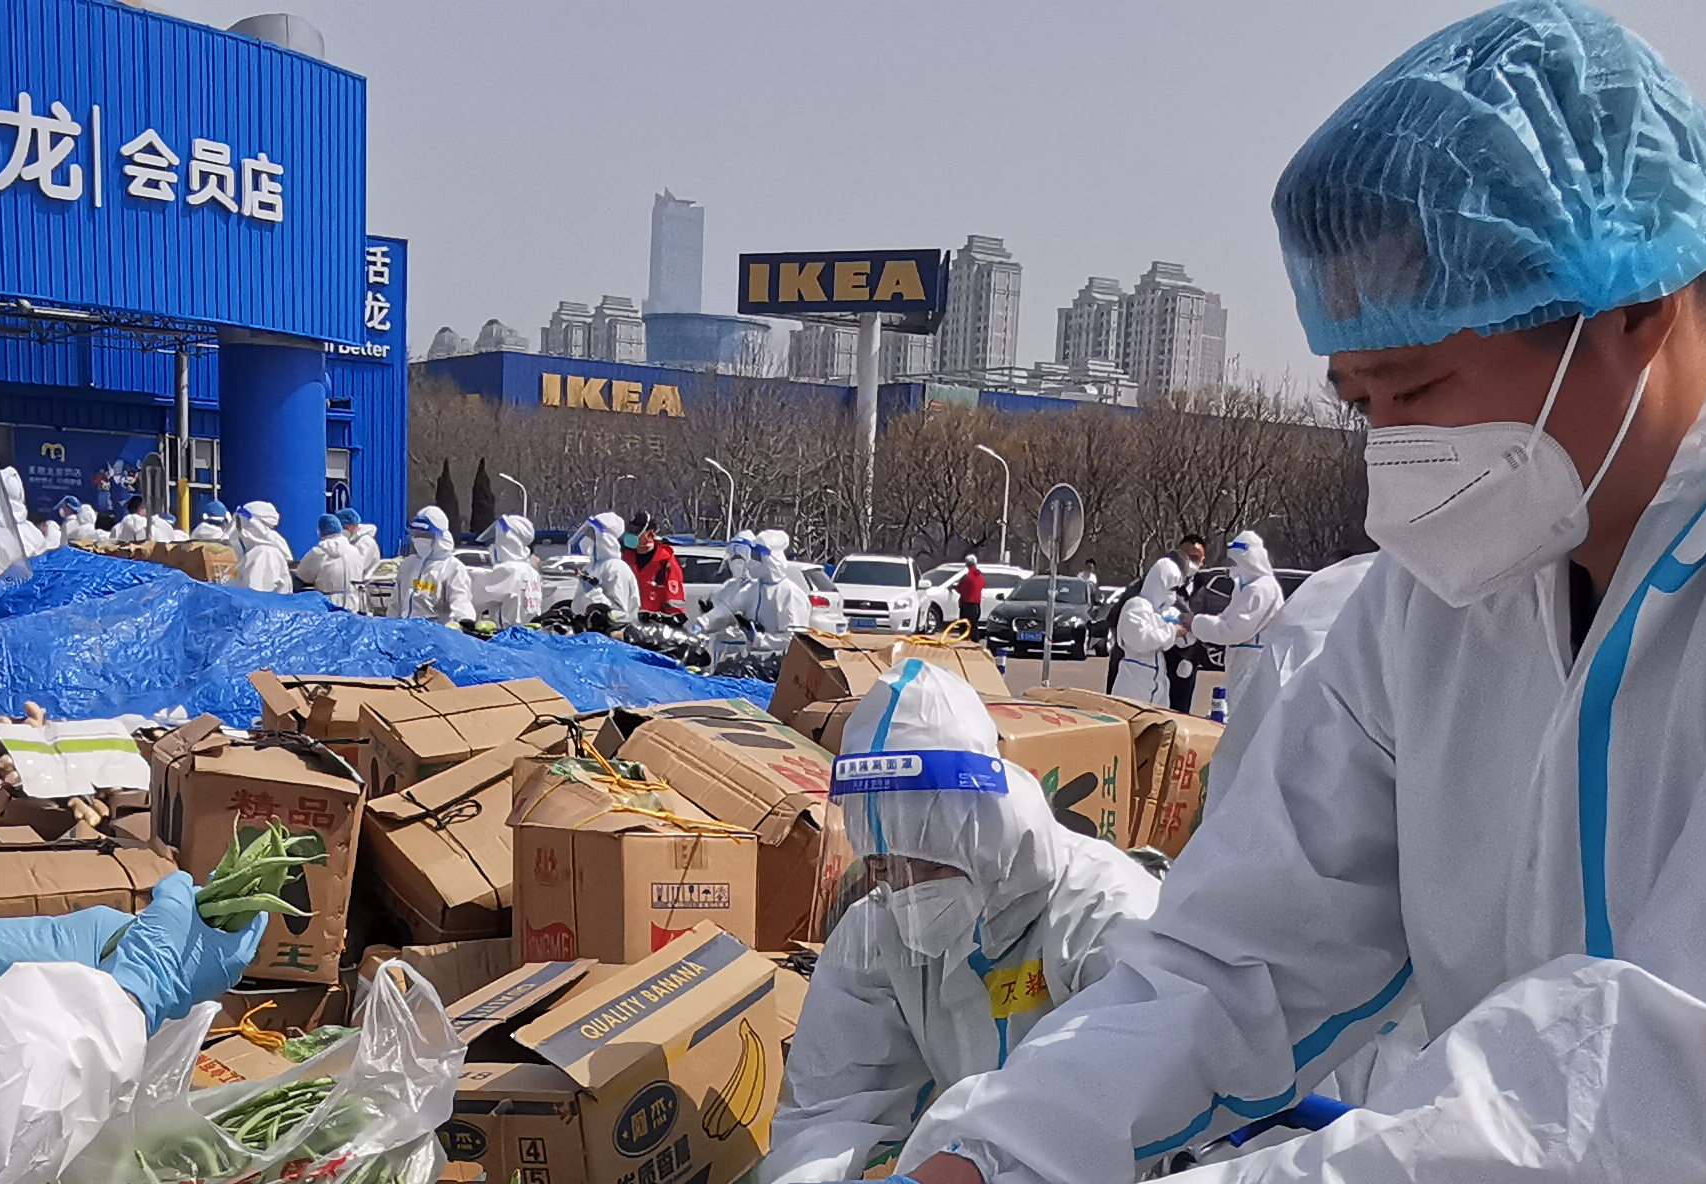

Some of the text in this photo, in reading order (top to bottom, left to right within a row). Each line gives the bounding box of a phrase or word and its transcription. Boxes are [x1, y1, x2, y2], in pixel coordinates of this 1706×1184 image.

[120, 127, 285, 223] 会员店
[748, 260, 927, 303] IKEA
[542, 373, 686, 418] IKEA
[580, 958, 708, 1041] QUALITY BANANA
[525, 1140, 541, 1161] 4
